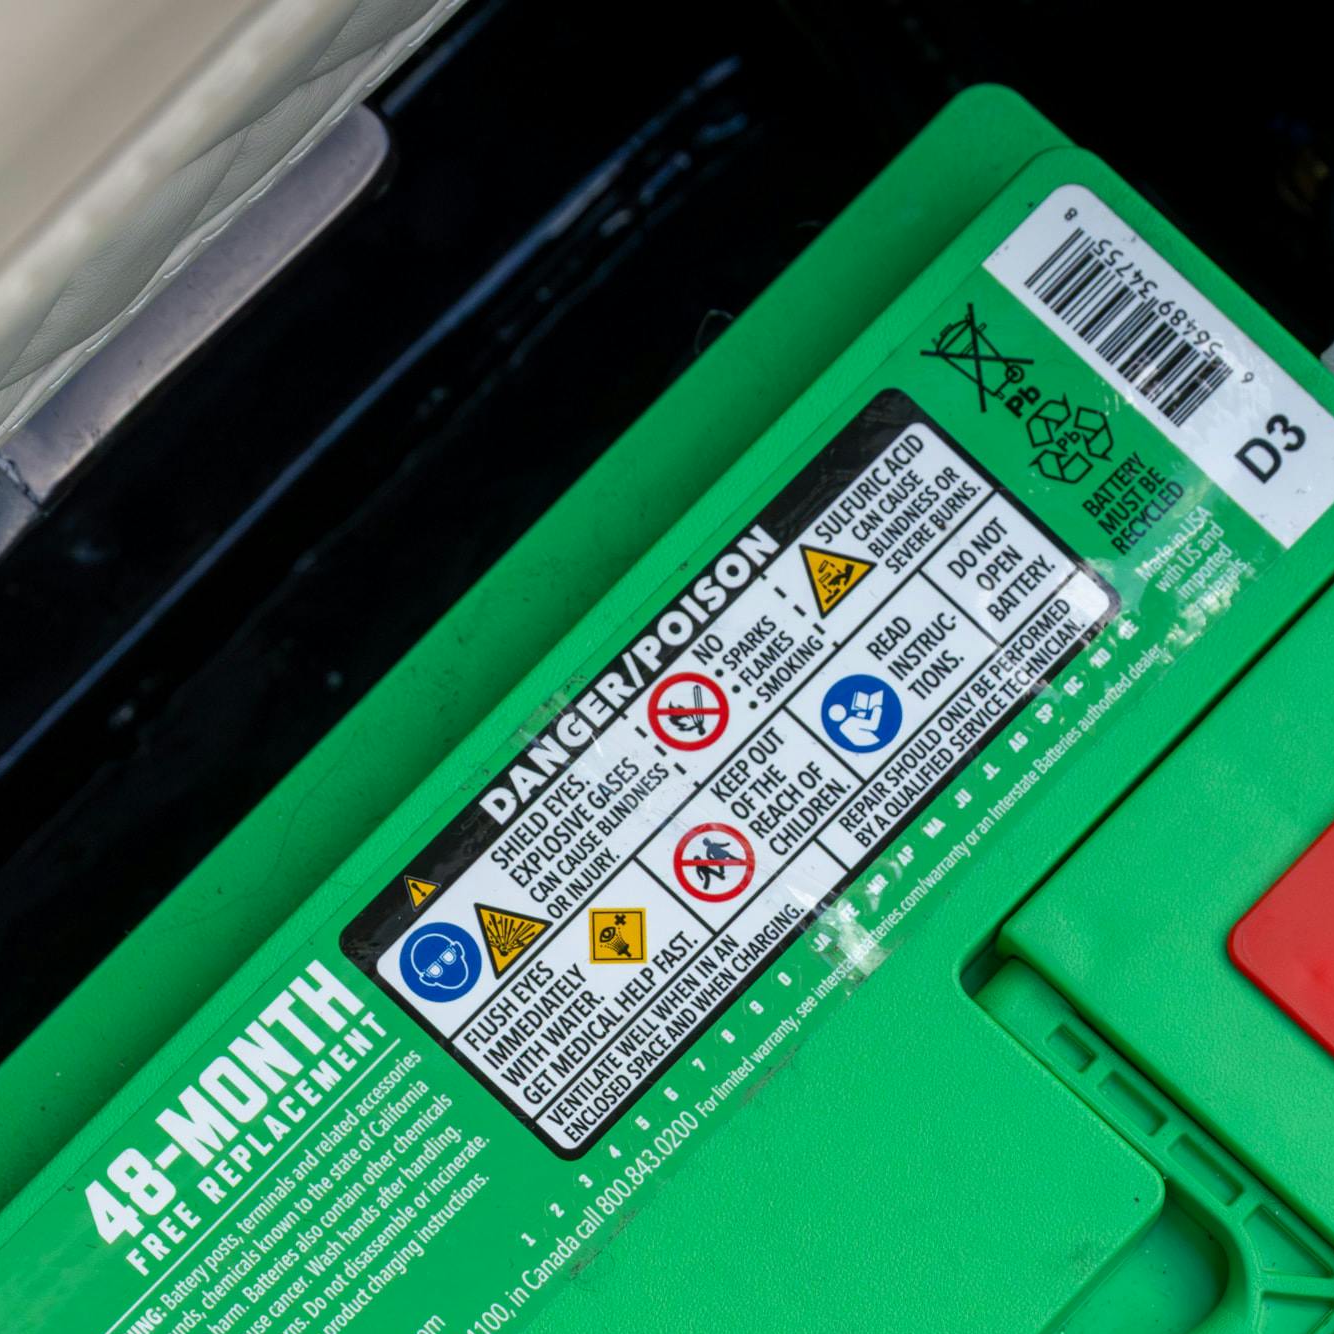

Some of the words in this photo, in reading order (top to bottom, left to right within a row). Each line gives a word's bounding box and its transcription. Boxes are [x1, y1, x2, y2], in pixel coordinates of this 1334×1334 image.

[1091, 233, 1160, 302] 34755
[1004, 386, 1041, 418] Pb
[1054, 426, 1085, 456] Pb
[1234, 414, 1306, 484] D3
[814, 467, 891, 545] SULFURIC
[883, 434, 924, 477] ACID
[851, 509, 884, 542] CAN
[878, 469, 924, 515] CAUSE
[867, 485, 940, 559] BLINDNESS
[934, 466, 961, 491] OR
[1082, 453, 1145, 517] BATTERY
[1098, 486, 1144, 535] MUST
[1138, 467, 1165, 494] BE
[1111, 482, 1179, 555] RECYCLED
[885, 523, 936, 575] SEVERE
[928, 480, 982, 532] BURNS.
[947, 549, 978, 579] DO
[970, 516, 1008, 556] NOT
[976, 544, 1023, 591] OPEN
[986, 554, 1056, 623] BATTERY.
[476, 521, 784, 829] DANGER/POISON
[691, 634, 724, 666] NO
[722, 615, 777, 671] SPARKS
[738, 630, 794, 687] FLAMES
[756, 635, 824, 703] SMOKING
[866, 616, 912, 661] READ
[887, 612, 956, 681] INSTRUC-
[907, 649, 965, 700] TIONS.
[709, 759, 751, 803] KEEP
[748, 726, 784, 765] OUT
[730, 791, 756, 820] OF
[748, 764, 787, 800] THE
[748, 783, 805, 839] REACH
[797, 761, 823, 790] OF
[490, 812, 549, 870] SHIELD
[542, 773, 591, 818] EYES.
[509, 803, 595, 888] EXPLOSIVE
[587, 757, 640, 810] GASES
[529, 870, 563, 903] CAN
[556, 830, 603, 876] CAUSE
[595, 762, 669, 837] BLINDNESS
[769, 778, 851, 856] CHILDREN.
[546, 894, 573, 919] OR
[564, 847, 620, 901] INJURY.
[463, 996, 519, 1052] FLUSH
[510, 960, 554, 1005] EYES
[482, 963, 586, 1070] IMMEDIATELY
[500, 1039, 551, 1087] WITH
[540, 990, 605, 1047] WATER.
[523, 1068, 558, 1105] GET
[549, 1007, 624, 1079] MEDICAL
[613, 967, 657, 1013] HELP
[651, 930, 698, 975] FAST.
[546, 1052, 623, 1126] VENTILATE
[614, 1018, 660, 1057] WELL
[650, 972, 701, 1021] WHEN
[694, 955, 719, 979] IN
[713, 934, 740, 962] AN
[563, 1074, 632, 1143] ENCLOSED
[626, 1034, 672, 1080] SPACE
[664, 1008, 698, 1043] AND
[690, 967, 738, 1013] WHEN
[731, 903, 805, 973] CHARGING.
[84, 959, 365, 1245] 48-MONTH
[125, 1201, 202, 1277] FREE
[197, 1011, 387, 1205] REPLACEMENT
[159, 1264, 211, 1311] Battery
[203, 1233, 244, 1273] posts,
[236, 1176, 297, 1235] terminals
[292, 1149, 320, 1181] and
[314, 1108, 360, 1157] related
[355, 1050, 422, 1117] accessories
[302, 1296, 328, 1319] Do
[323, 1273, 350, 1300] not
[343, 1205, 418, 1279] disassemble
[413, 1190, 431, 1209] or
[423, 1136, 490, 1196] incinerate.
[505, 1287, 530, 1308] in
[521, 1235, 581, 1291] Canada
[575, 1205, 605, 1240] call
[595, 1110, 699, 1215] 800.843.0200
